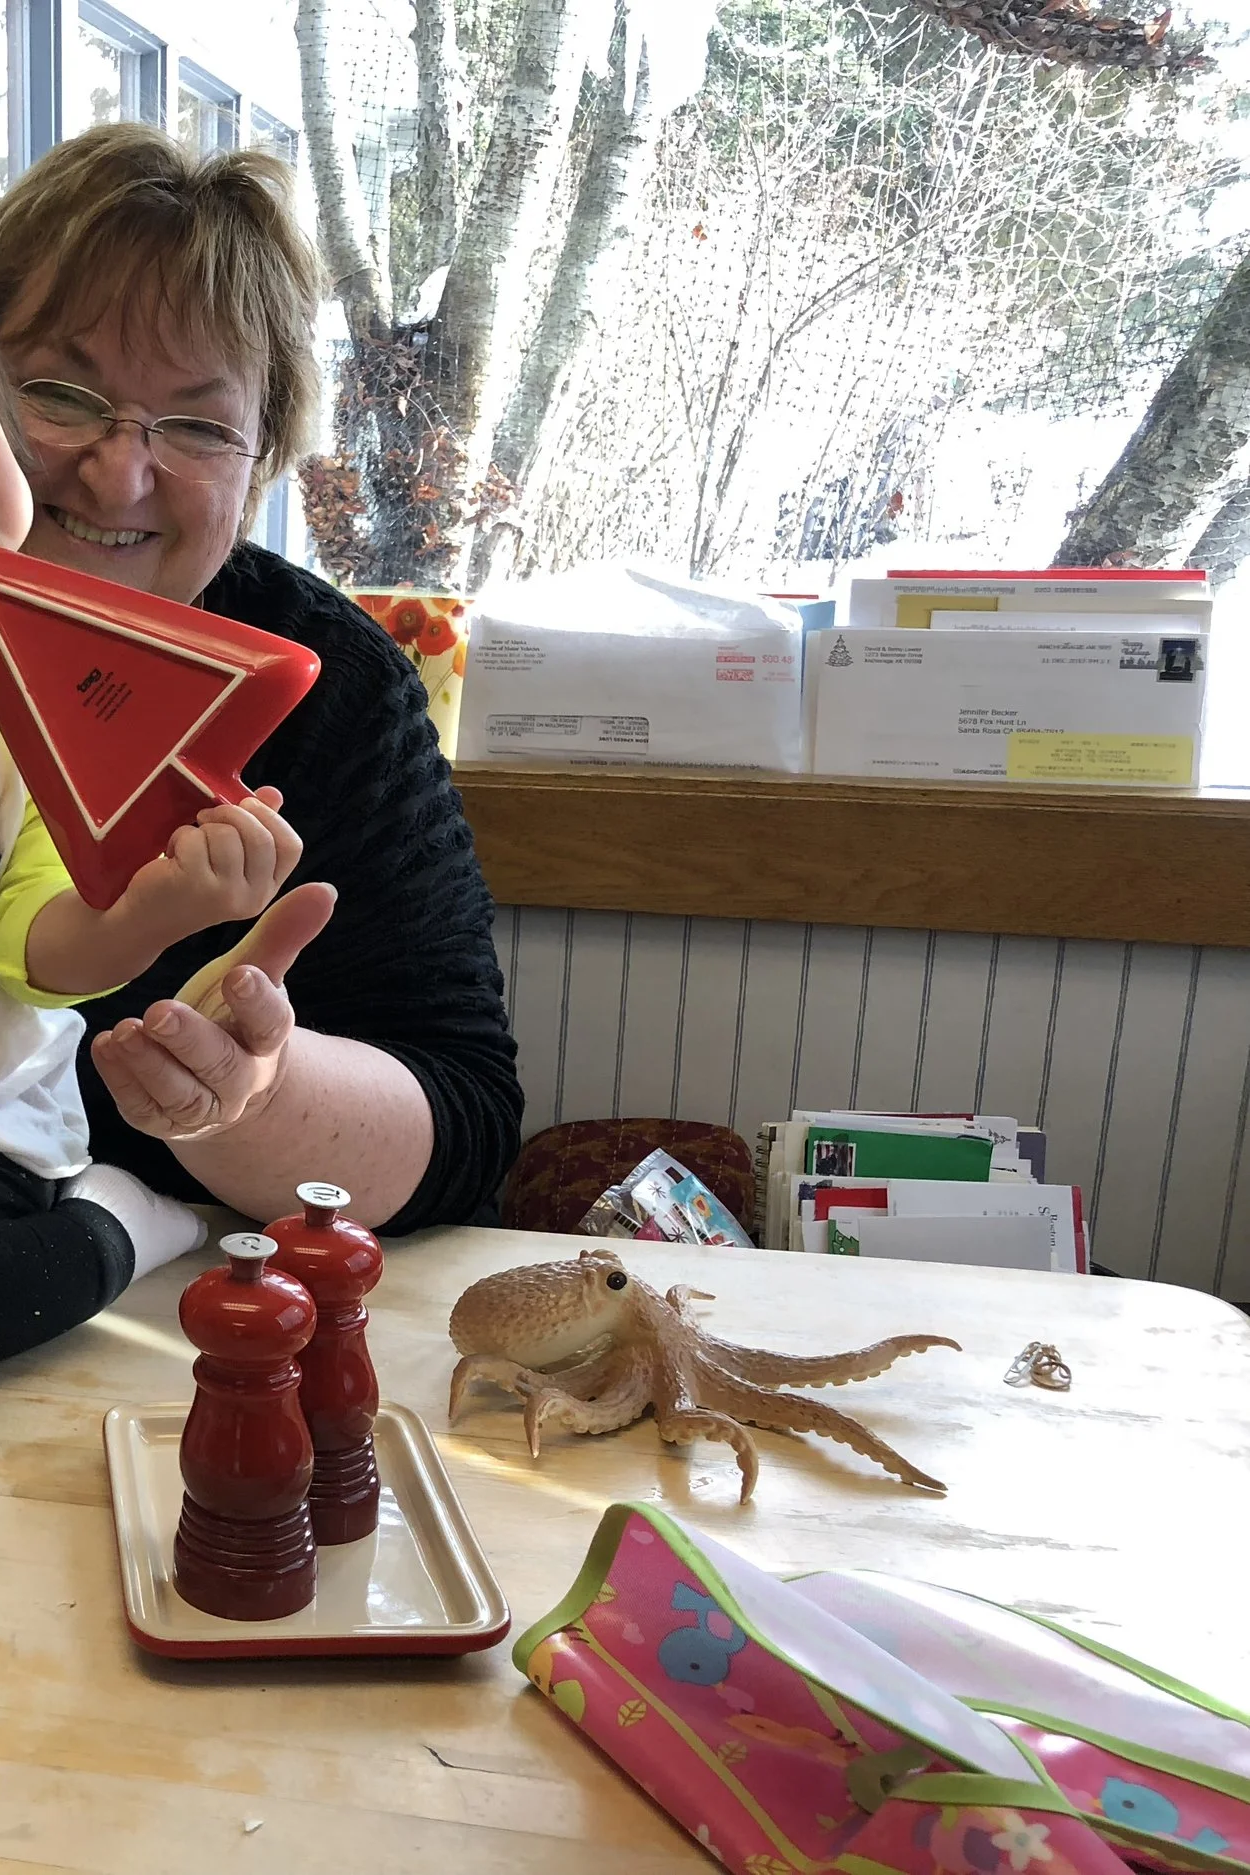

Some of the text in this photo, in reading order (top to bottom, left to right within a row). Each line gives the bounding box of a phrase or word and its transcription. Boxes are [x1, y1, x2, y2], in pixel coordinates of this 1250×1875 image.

[958, 708, 1018, 717] Jennifer Becker
[958, 717, 978, 725] 5678
[995, 718, 1015, 726] Hunt
[982, 727, 1001, 735] Rosa
